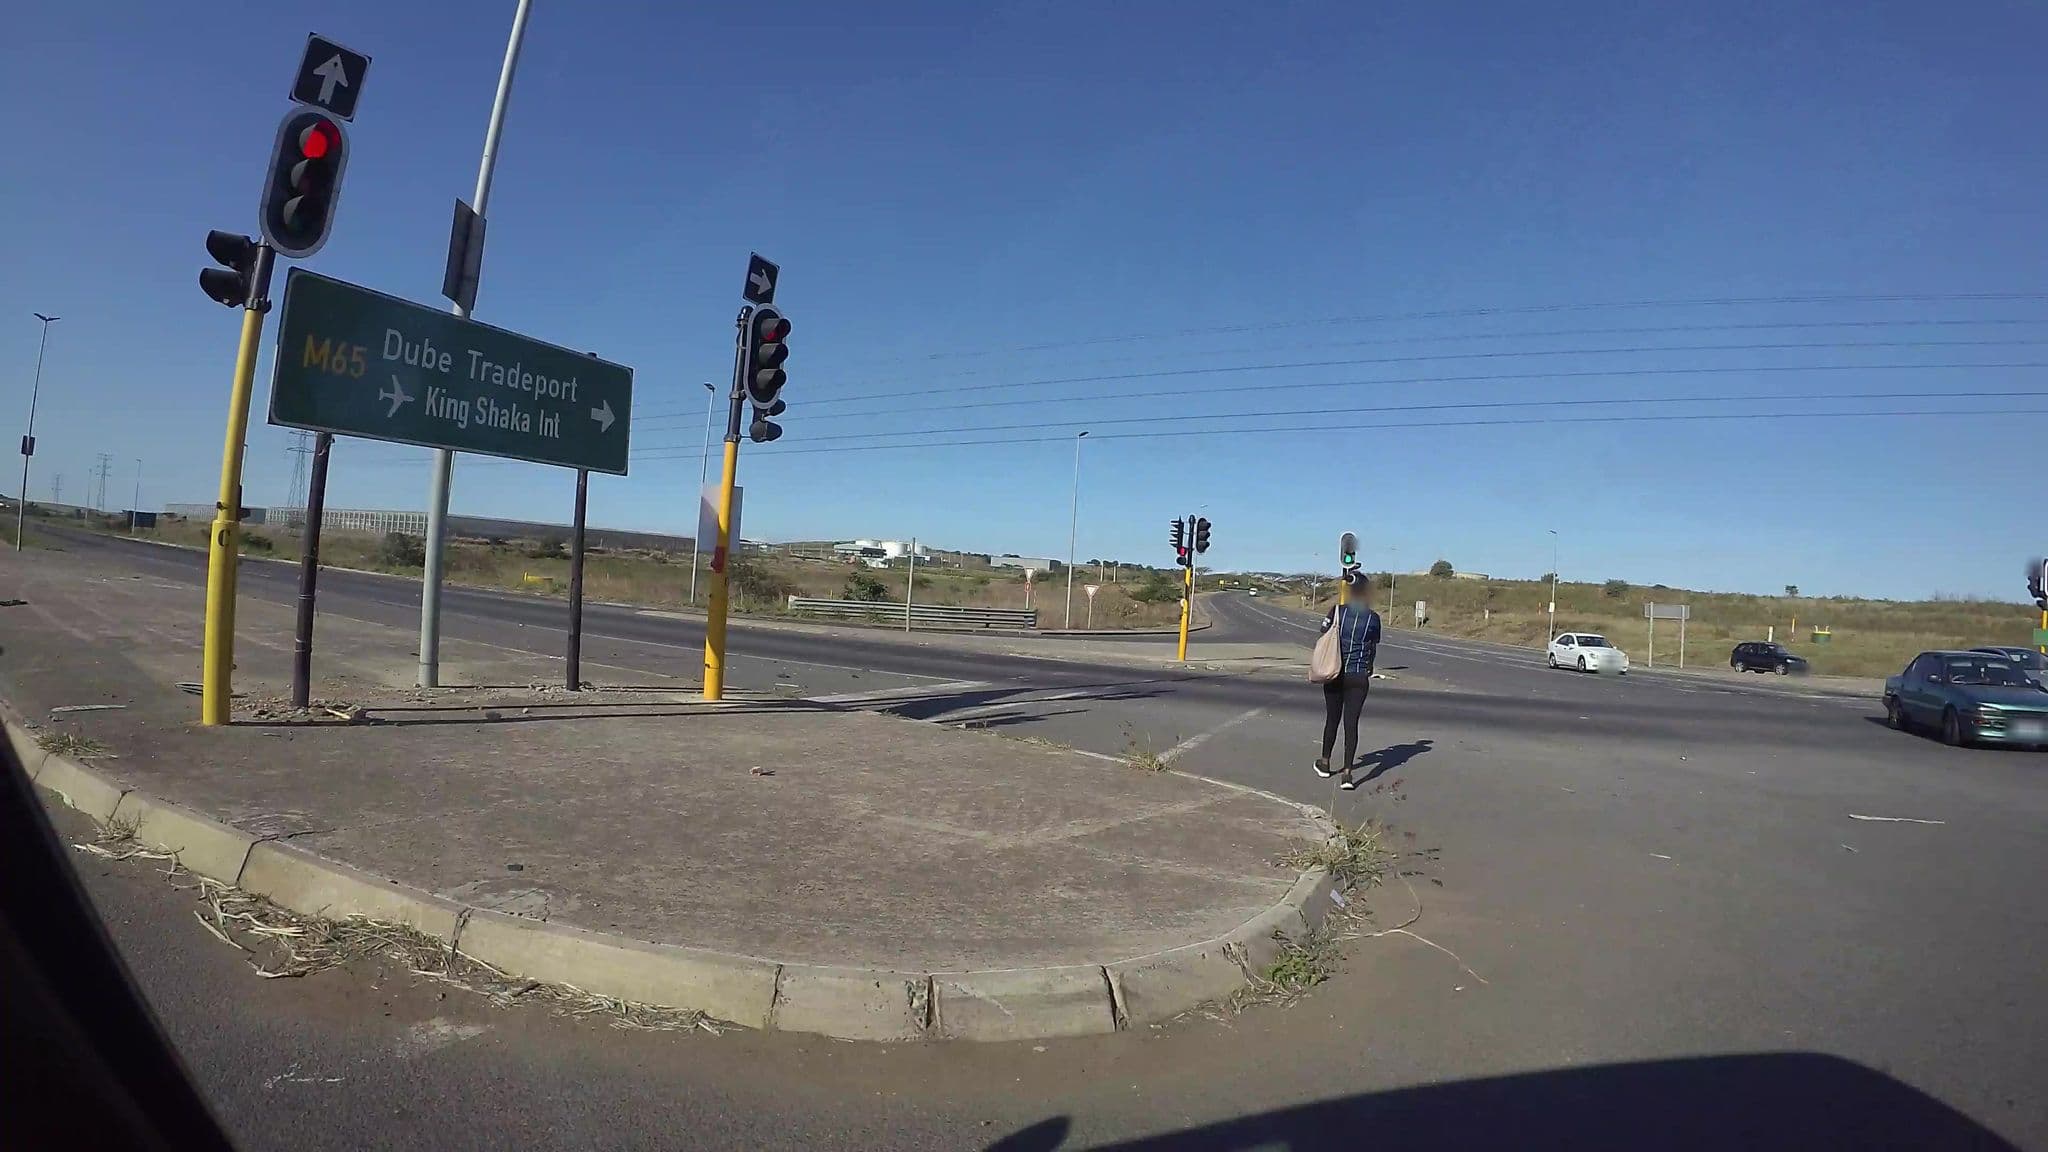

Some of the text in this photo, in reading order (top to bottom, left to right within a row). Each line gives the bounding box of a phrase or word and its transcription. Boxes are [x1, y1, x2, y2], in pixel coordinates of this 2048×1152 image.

[303, 334, 368, 378] M65
[382, 328, 578, 402] Dube Tradeport
[425, 386, 560, 439] King Shaka Int
